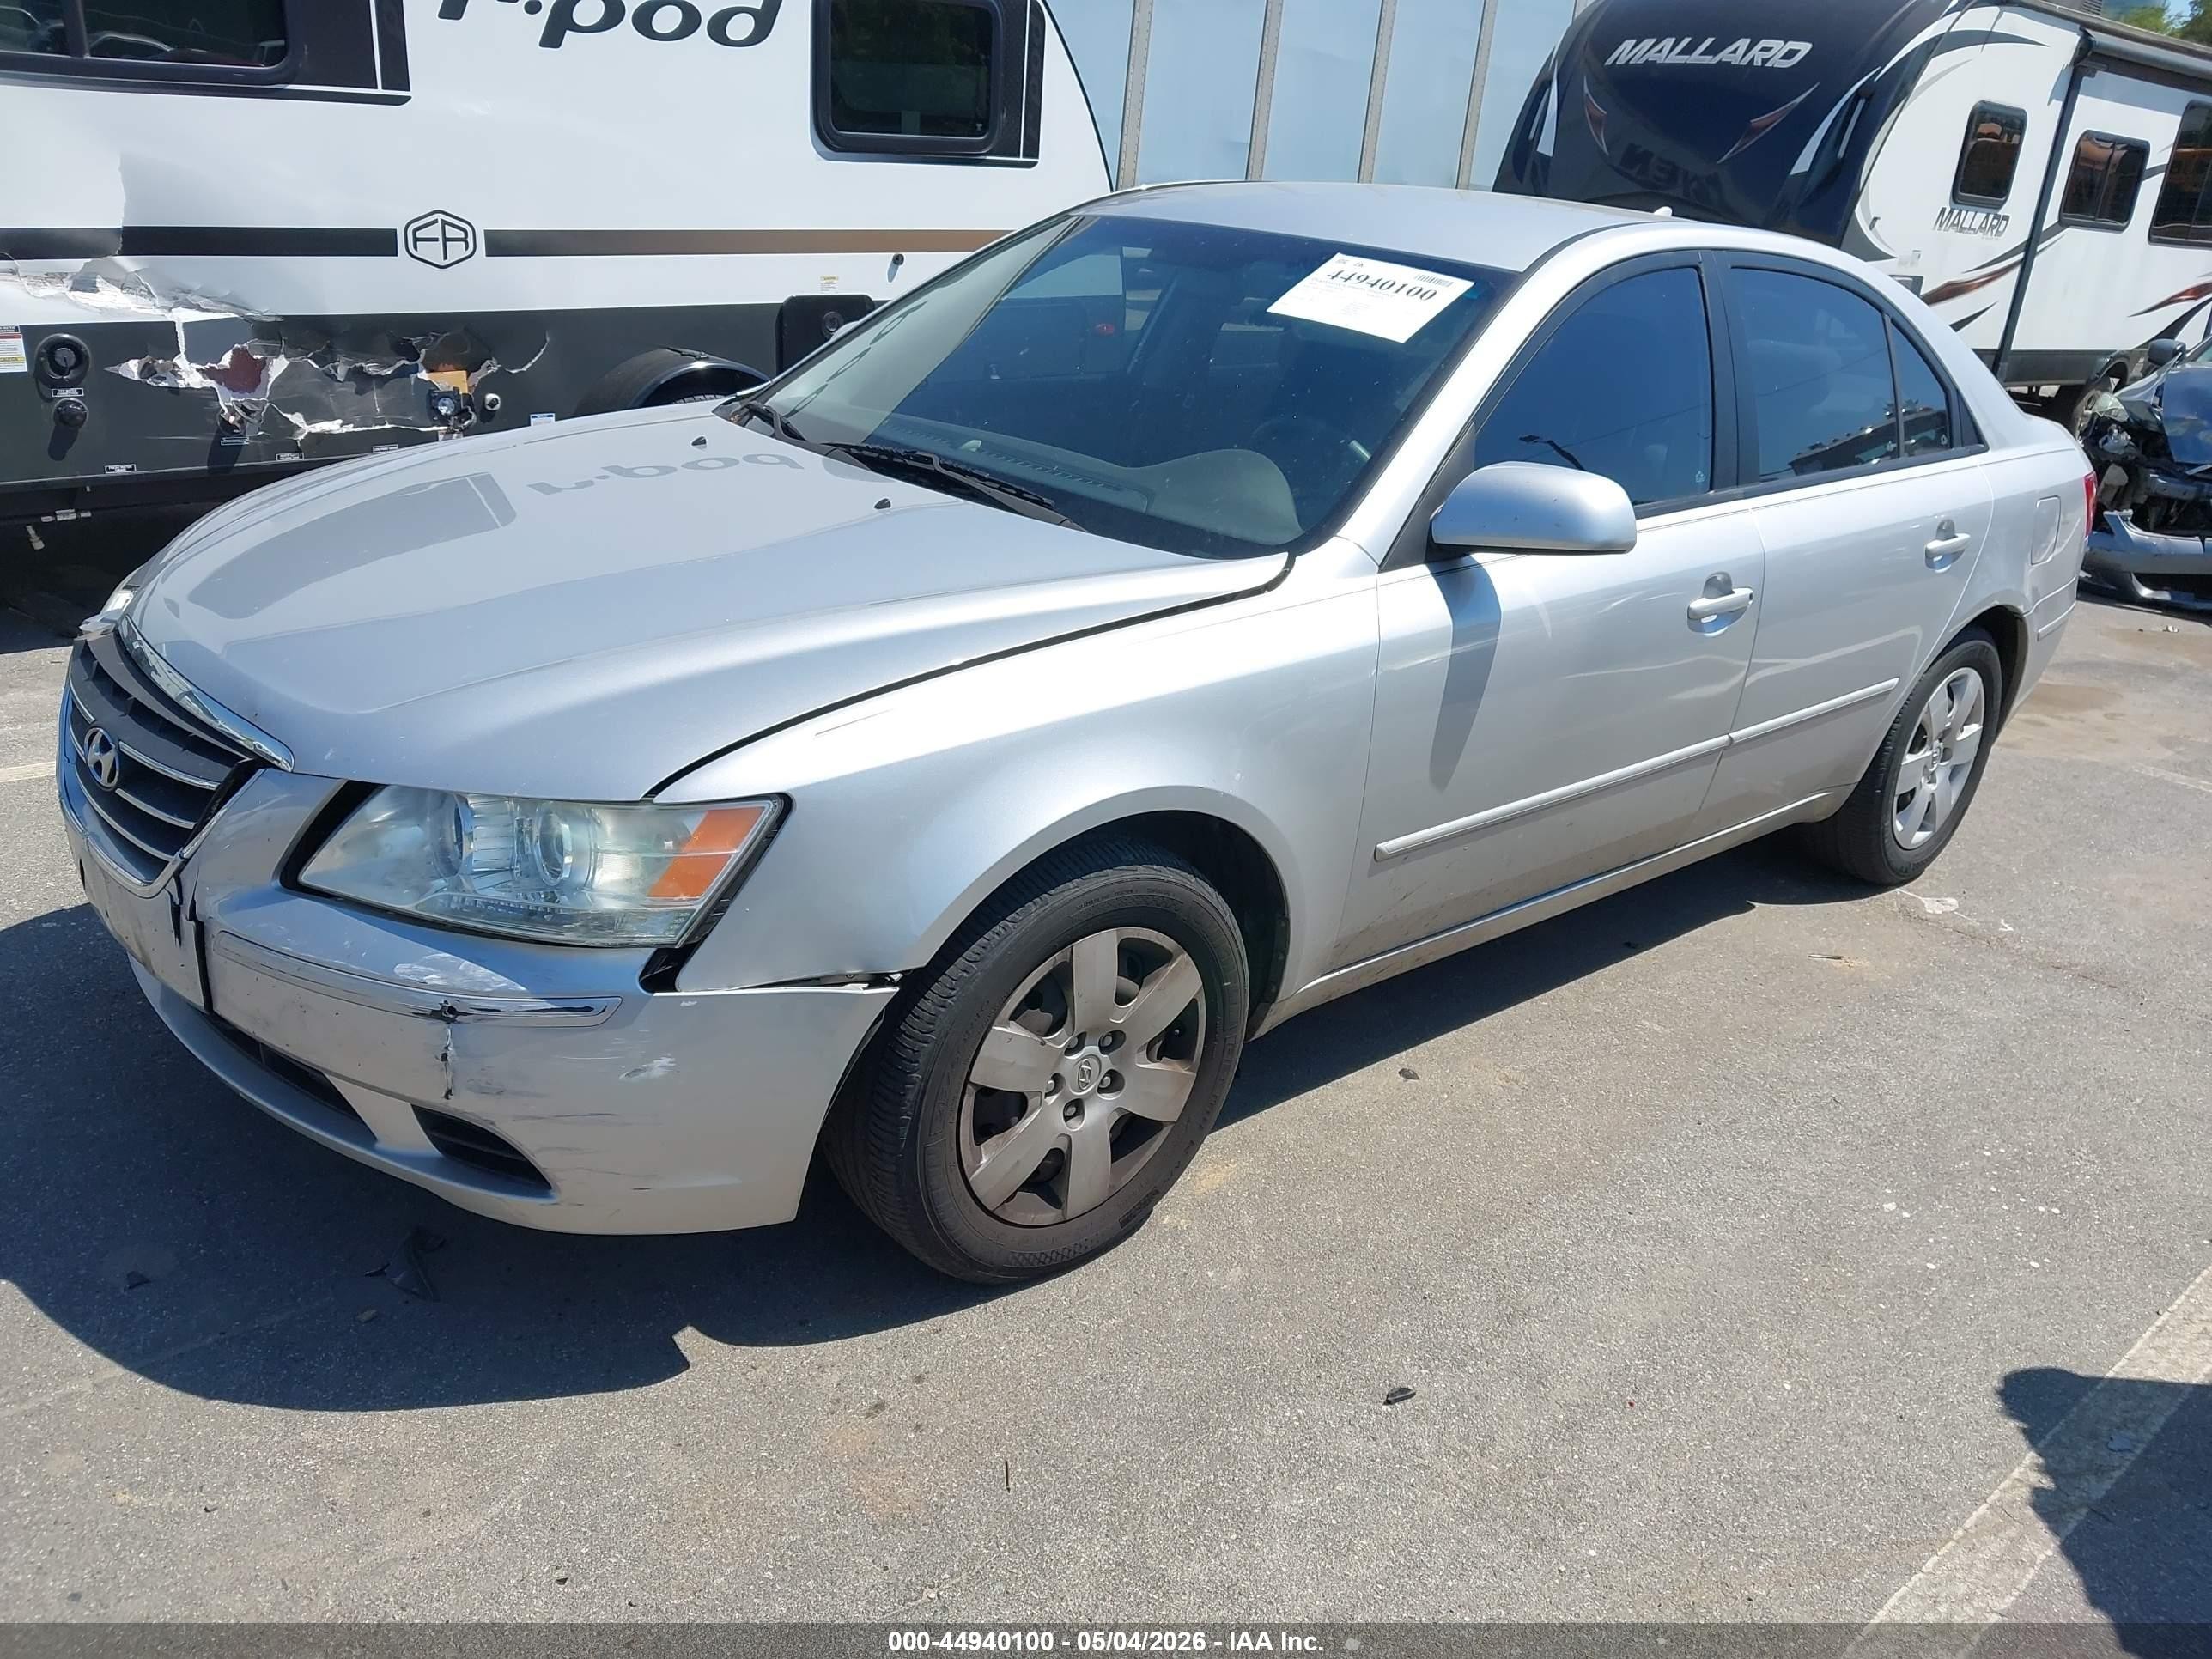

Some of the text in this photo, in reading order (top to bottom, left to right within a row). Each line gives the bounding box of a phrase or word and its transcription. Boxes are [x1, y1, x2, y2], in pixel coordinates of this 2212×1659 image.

[1605, 37, 1813, 68] MALLARD
[1932, 207, 2011, 237] MALLARD
[411, 218, 470, 261] FR
[1327, 270, 1438, 301] 44940100
